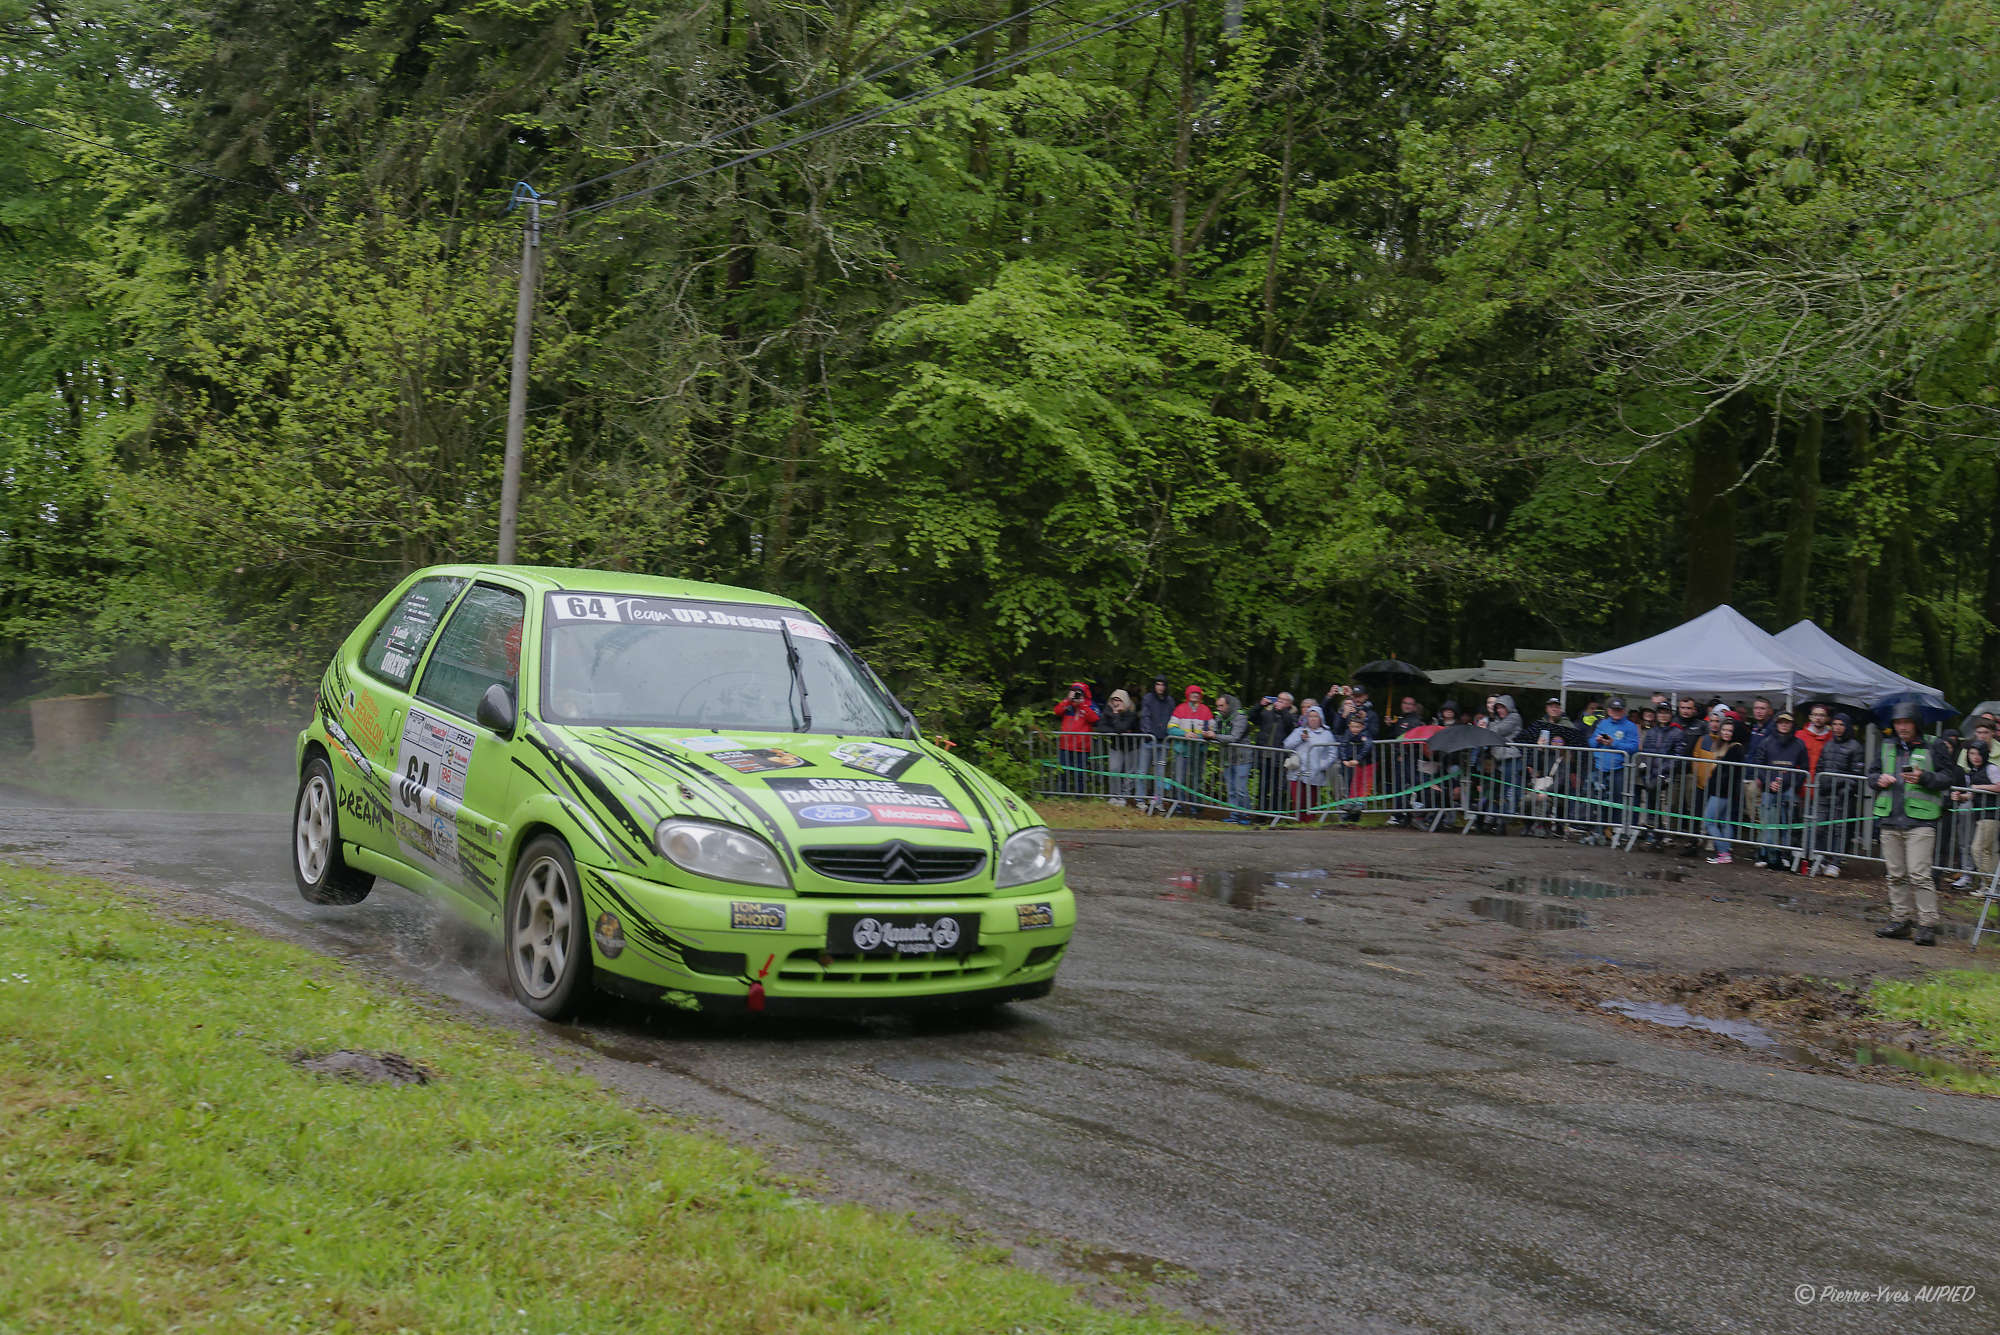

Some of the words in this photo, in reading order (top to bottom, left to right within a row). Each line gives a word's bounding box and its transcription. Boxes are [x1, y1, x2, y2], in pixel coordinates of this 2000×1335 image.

[567, 597, 607, 618] 64
[616, 598, 673, 621] Team
[399, 755, 430, 815] 64
[809, 779, 904, 793] GARAGE
[339, 783, 383, 832] DREAM
[781, 790, 851, 804] DAVID
[855, 791, 950, 808] TRICHET
[815, 804, 857, 819] Ford
[877, 808, 958, 824] Motorcraft
[734, 913, 779, 926] PHOTO
